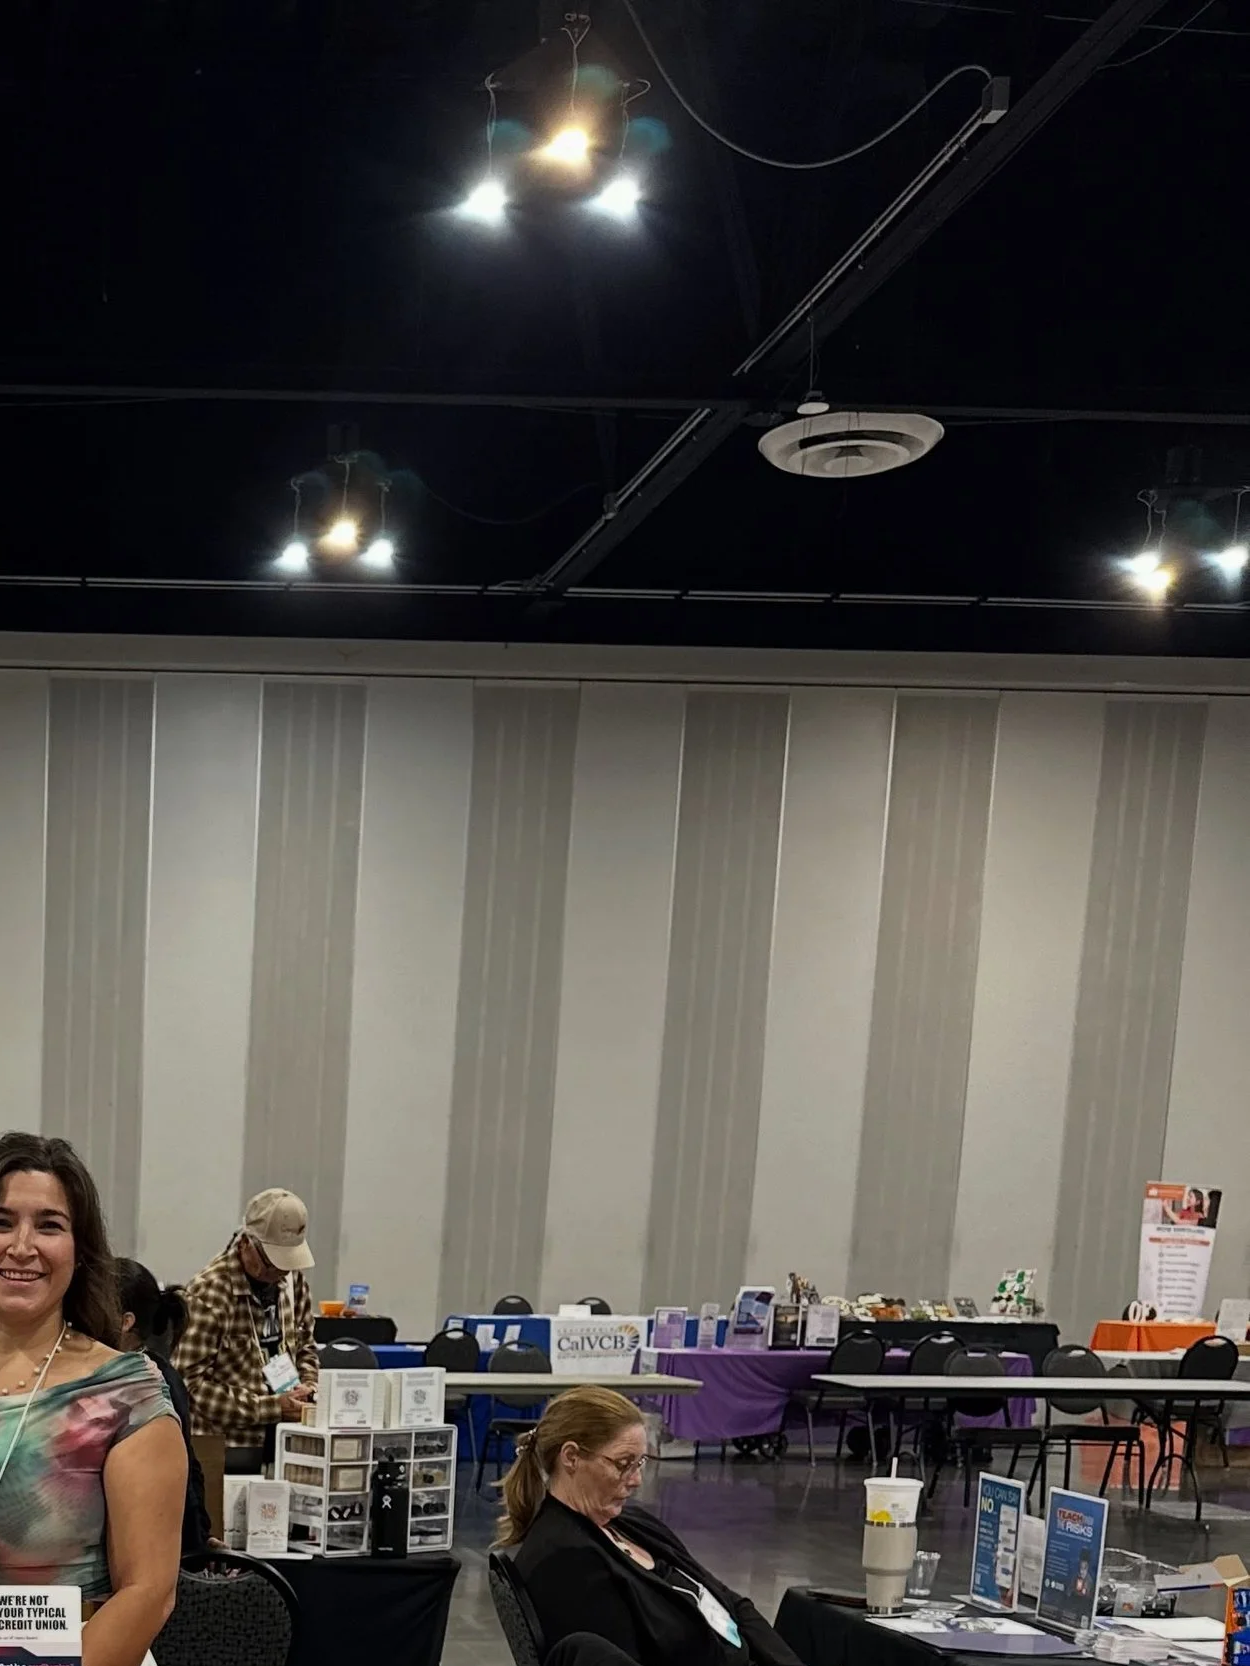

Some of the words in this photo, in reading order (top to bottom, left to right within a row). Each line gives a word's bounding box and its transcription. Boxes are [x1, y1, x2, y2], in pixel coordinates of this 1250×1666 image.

[558, 1335, 624, 1351] CalVCB
[1066, 1523, 1093, 1537] RISKS
[30, 1596, 48, 1605] NOT
[27, 1608, 66, 1618] TYPICAL
[36, 1620, 68, 1630] UNION.
